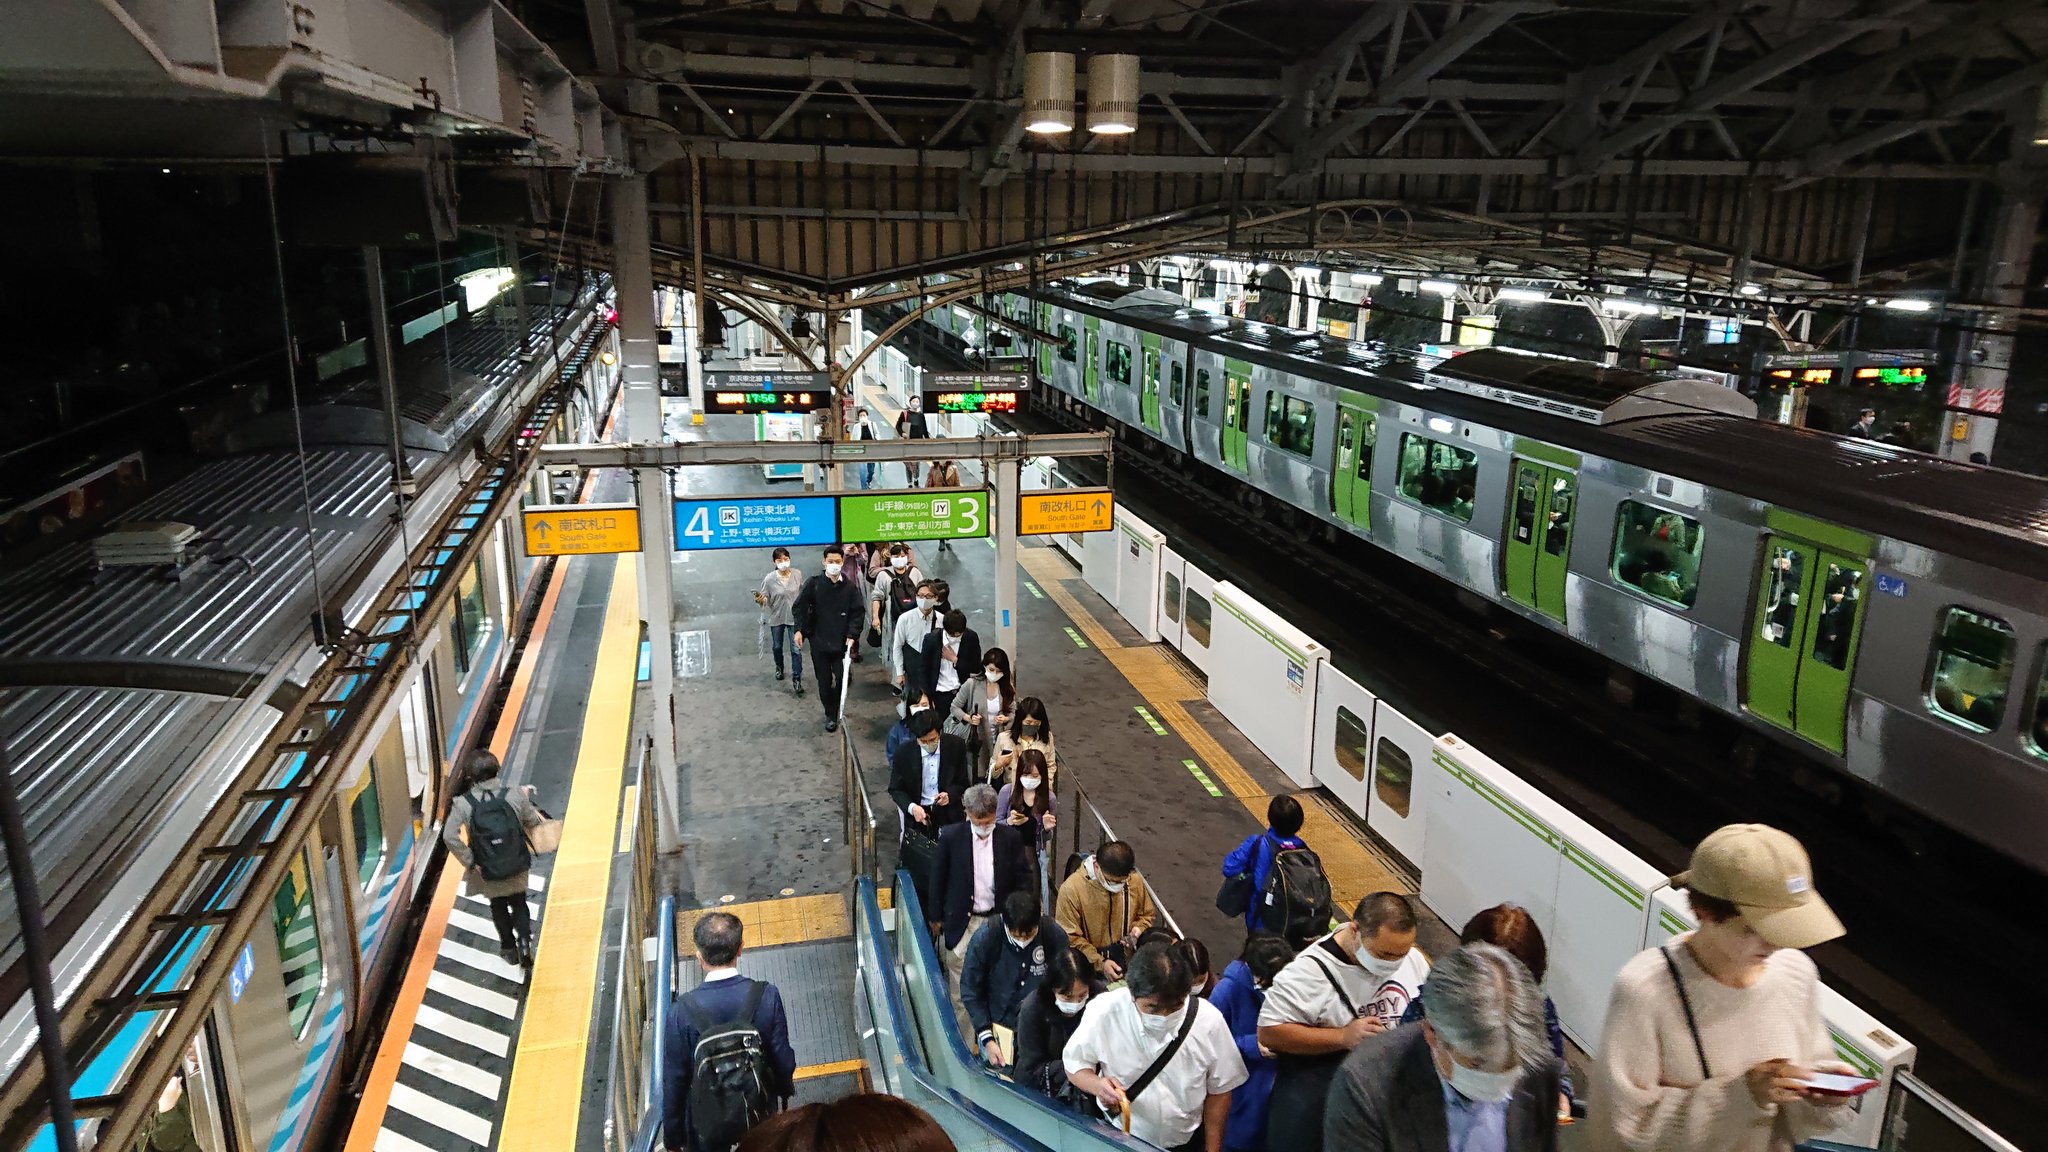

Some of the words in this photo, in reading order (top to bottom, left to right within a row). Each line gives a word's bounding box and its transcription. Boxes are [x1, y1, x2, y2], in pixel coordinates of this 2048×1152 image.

[1765, 355, 1774, 367] 2
[706, 374, 717, 388] 4
[1019, 375, 1028, 388] 3
[745, 392, 776, 404] 17:56
[743, 504, 796, 516] 京浜東北線
[957, 497, 979, 533] 3
[684, 507, 714, 544] 4
[587, 532, 607, 540] Gate
